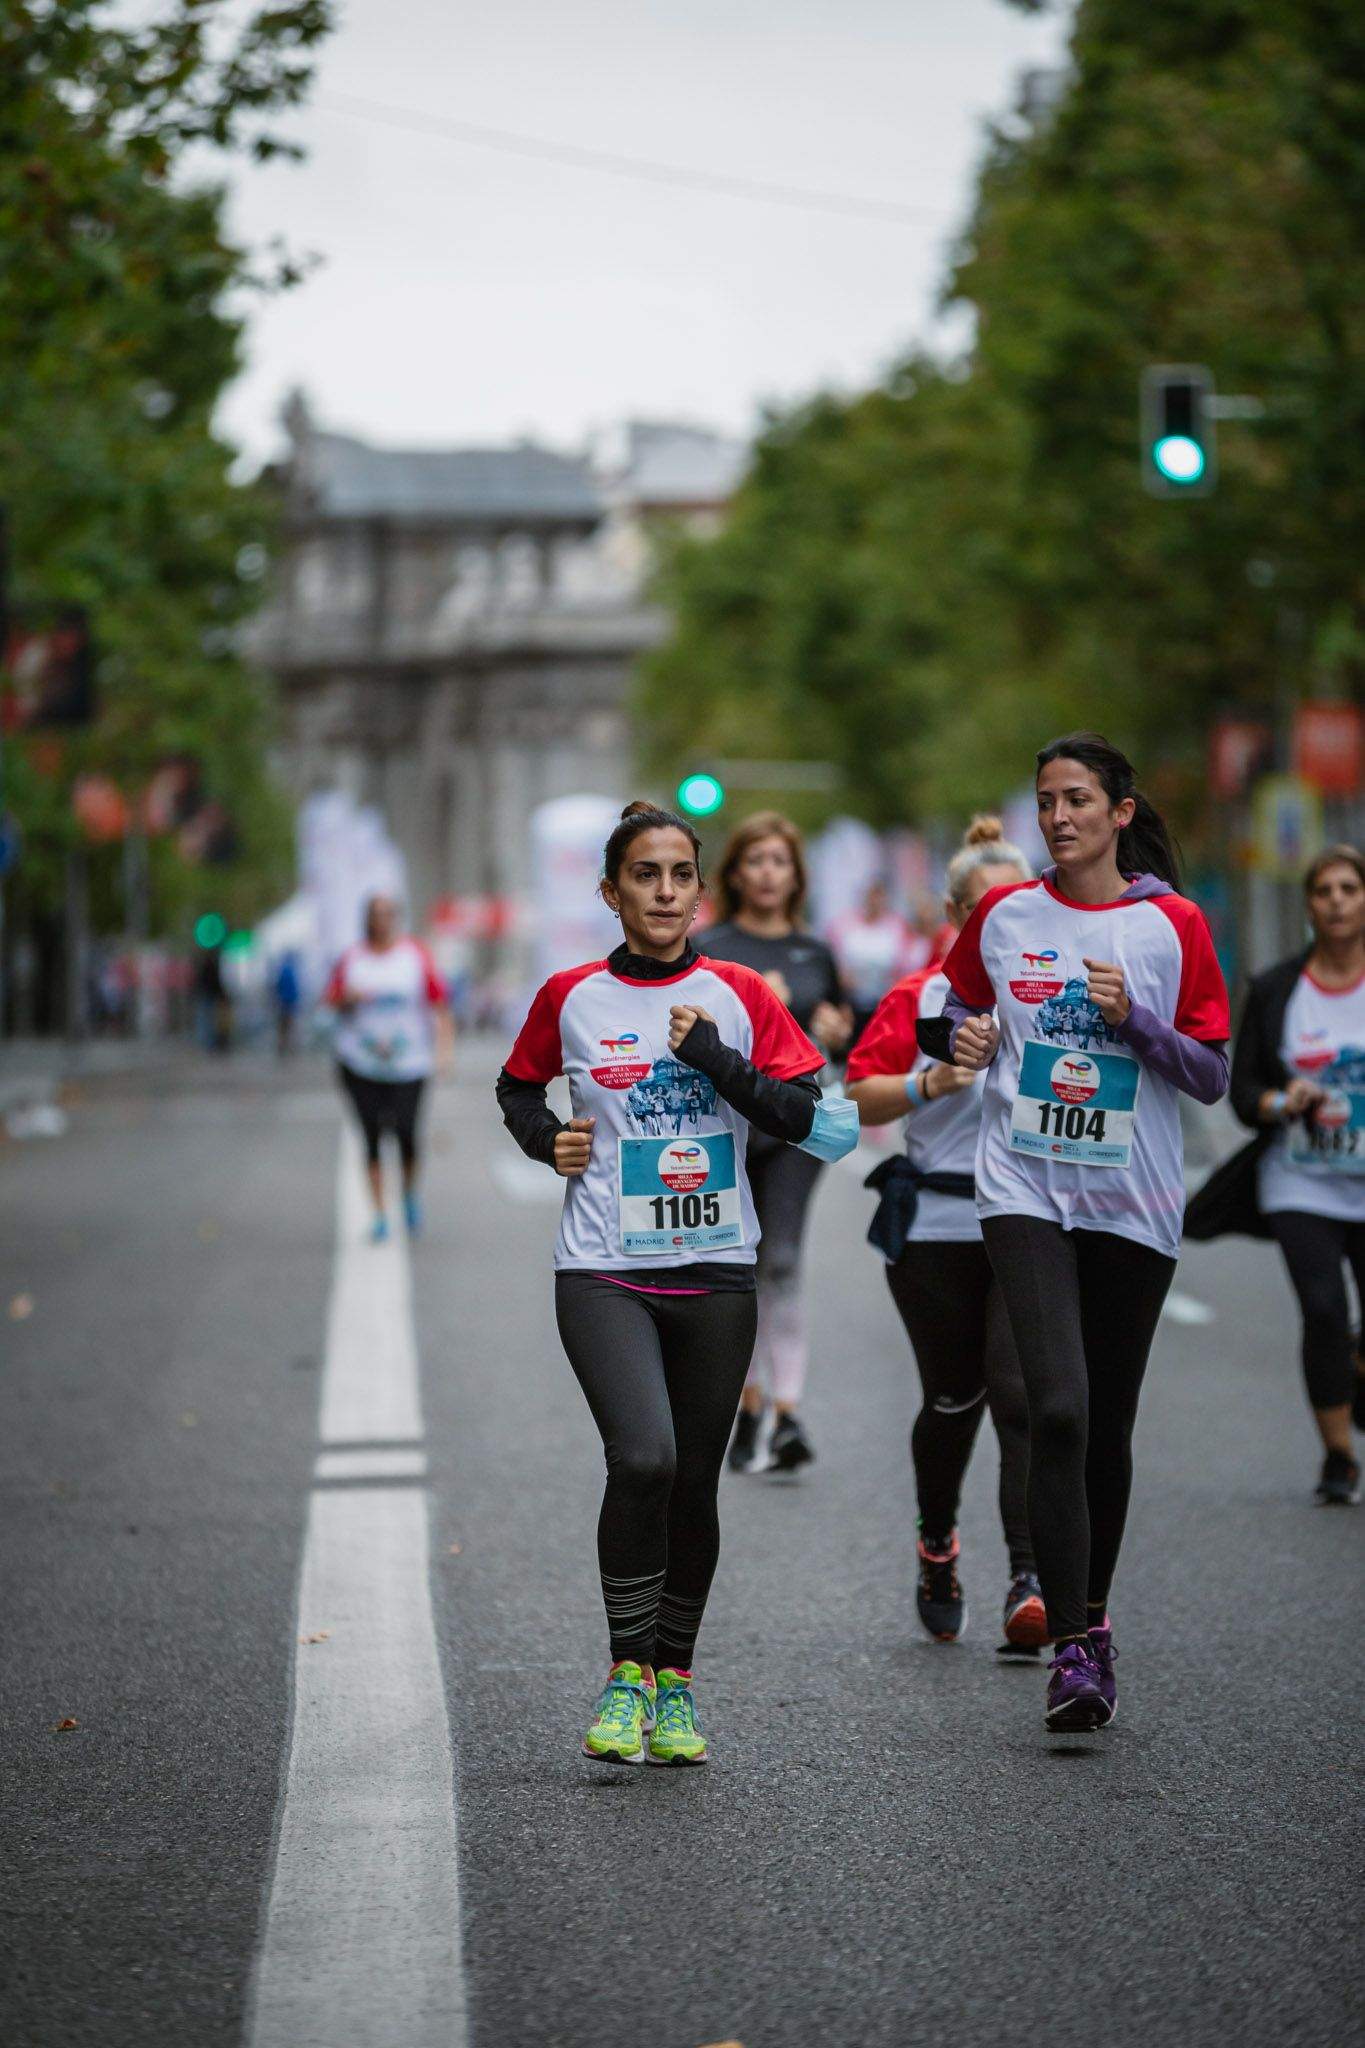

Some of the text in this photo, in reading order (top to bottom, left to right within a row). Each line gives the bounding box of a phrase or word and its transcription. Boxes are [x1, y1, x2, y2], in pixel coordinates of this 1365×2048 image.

[600, 1055, 640, 1063] TotalEnergies
[1039, 1102, 1106, 1142] 1104
[649, 1192, 720, 1229] 1105
